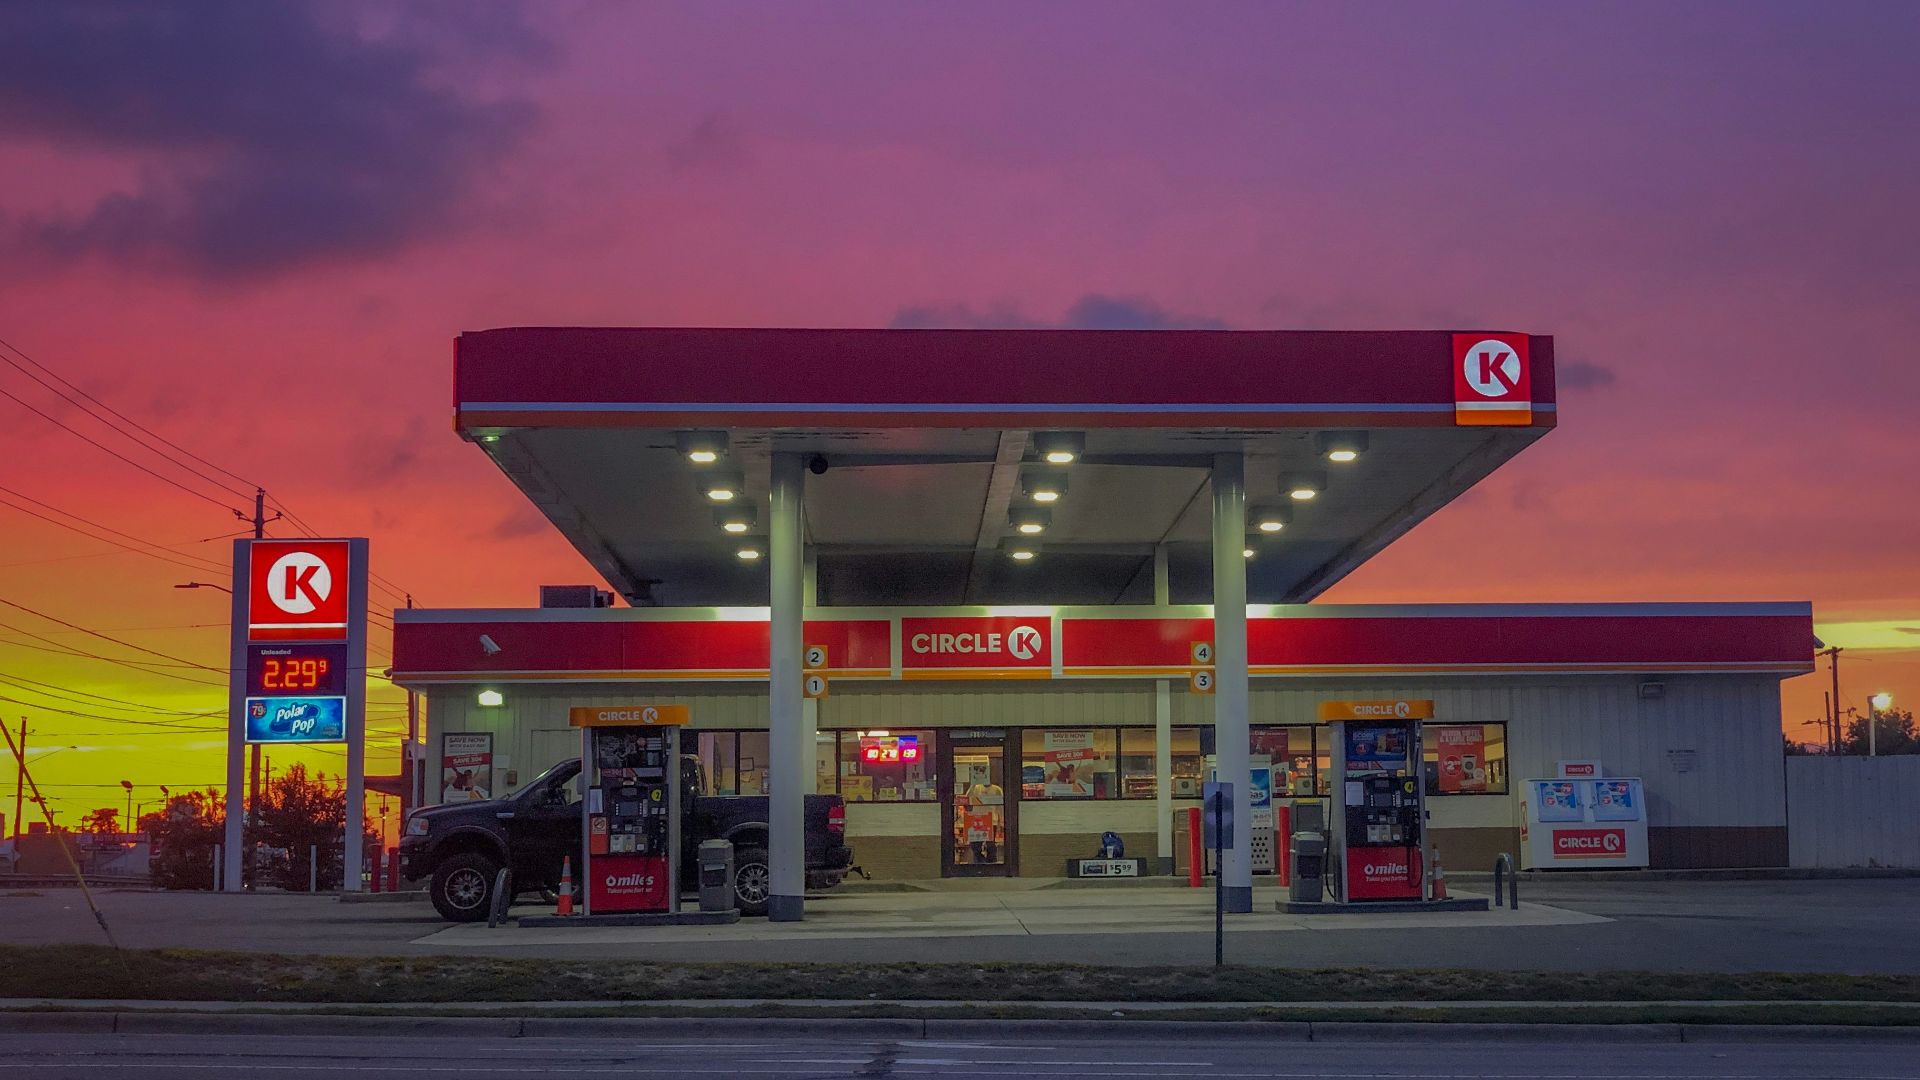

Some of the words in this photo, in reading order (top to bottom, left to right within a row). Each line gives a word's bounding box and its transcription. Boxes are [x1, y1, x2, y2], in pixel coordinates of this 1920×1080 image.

[911, 632, 1002, 654] CIRCLE
[276, 704, 308, 722] Polar
[1354, 704, 1394, 716] CIRCLE
[598, 711, 640, 722] CIRCLE
[292, 718, 314, 734] Pop
[1558, 837, 1600, 848] CIRCLE
[1379, 863, 1408, 874] miles
